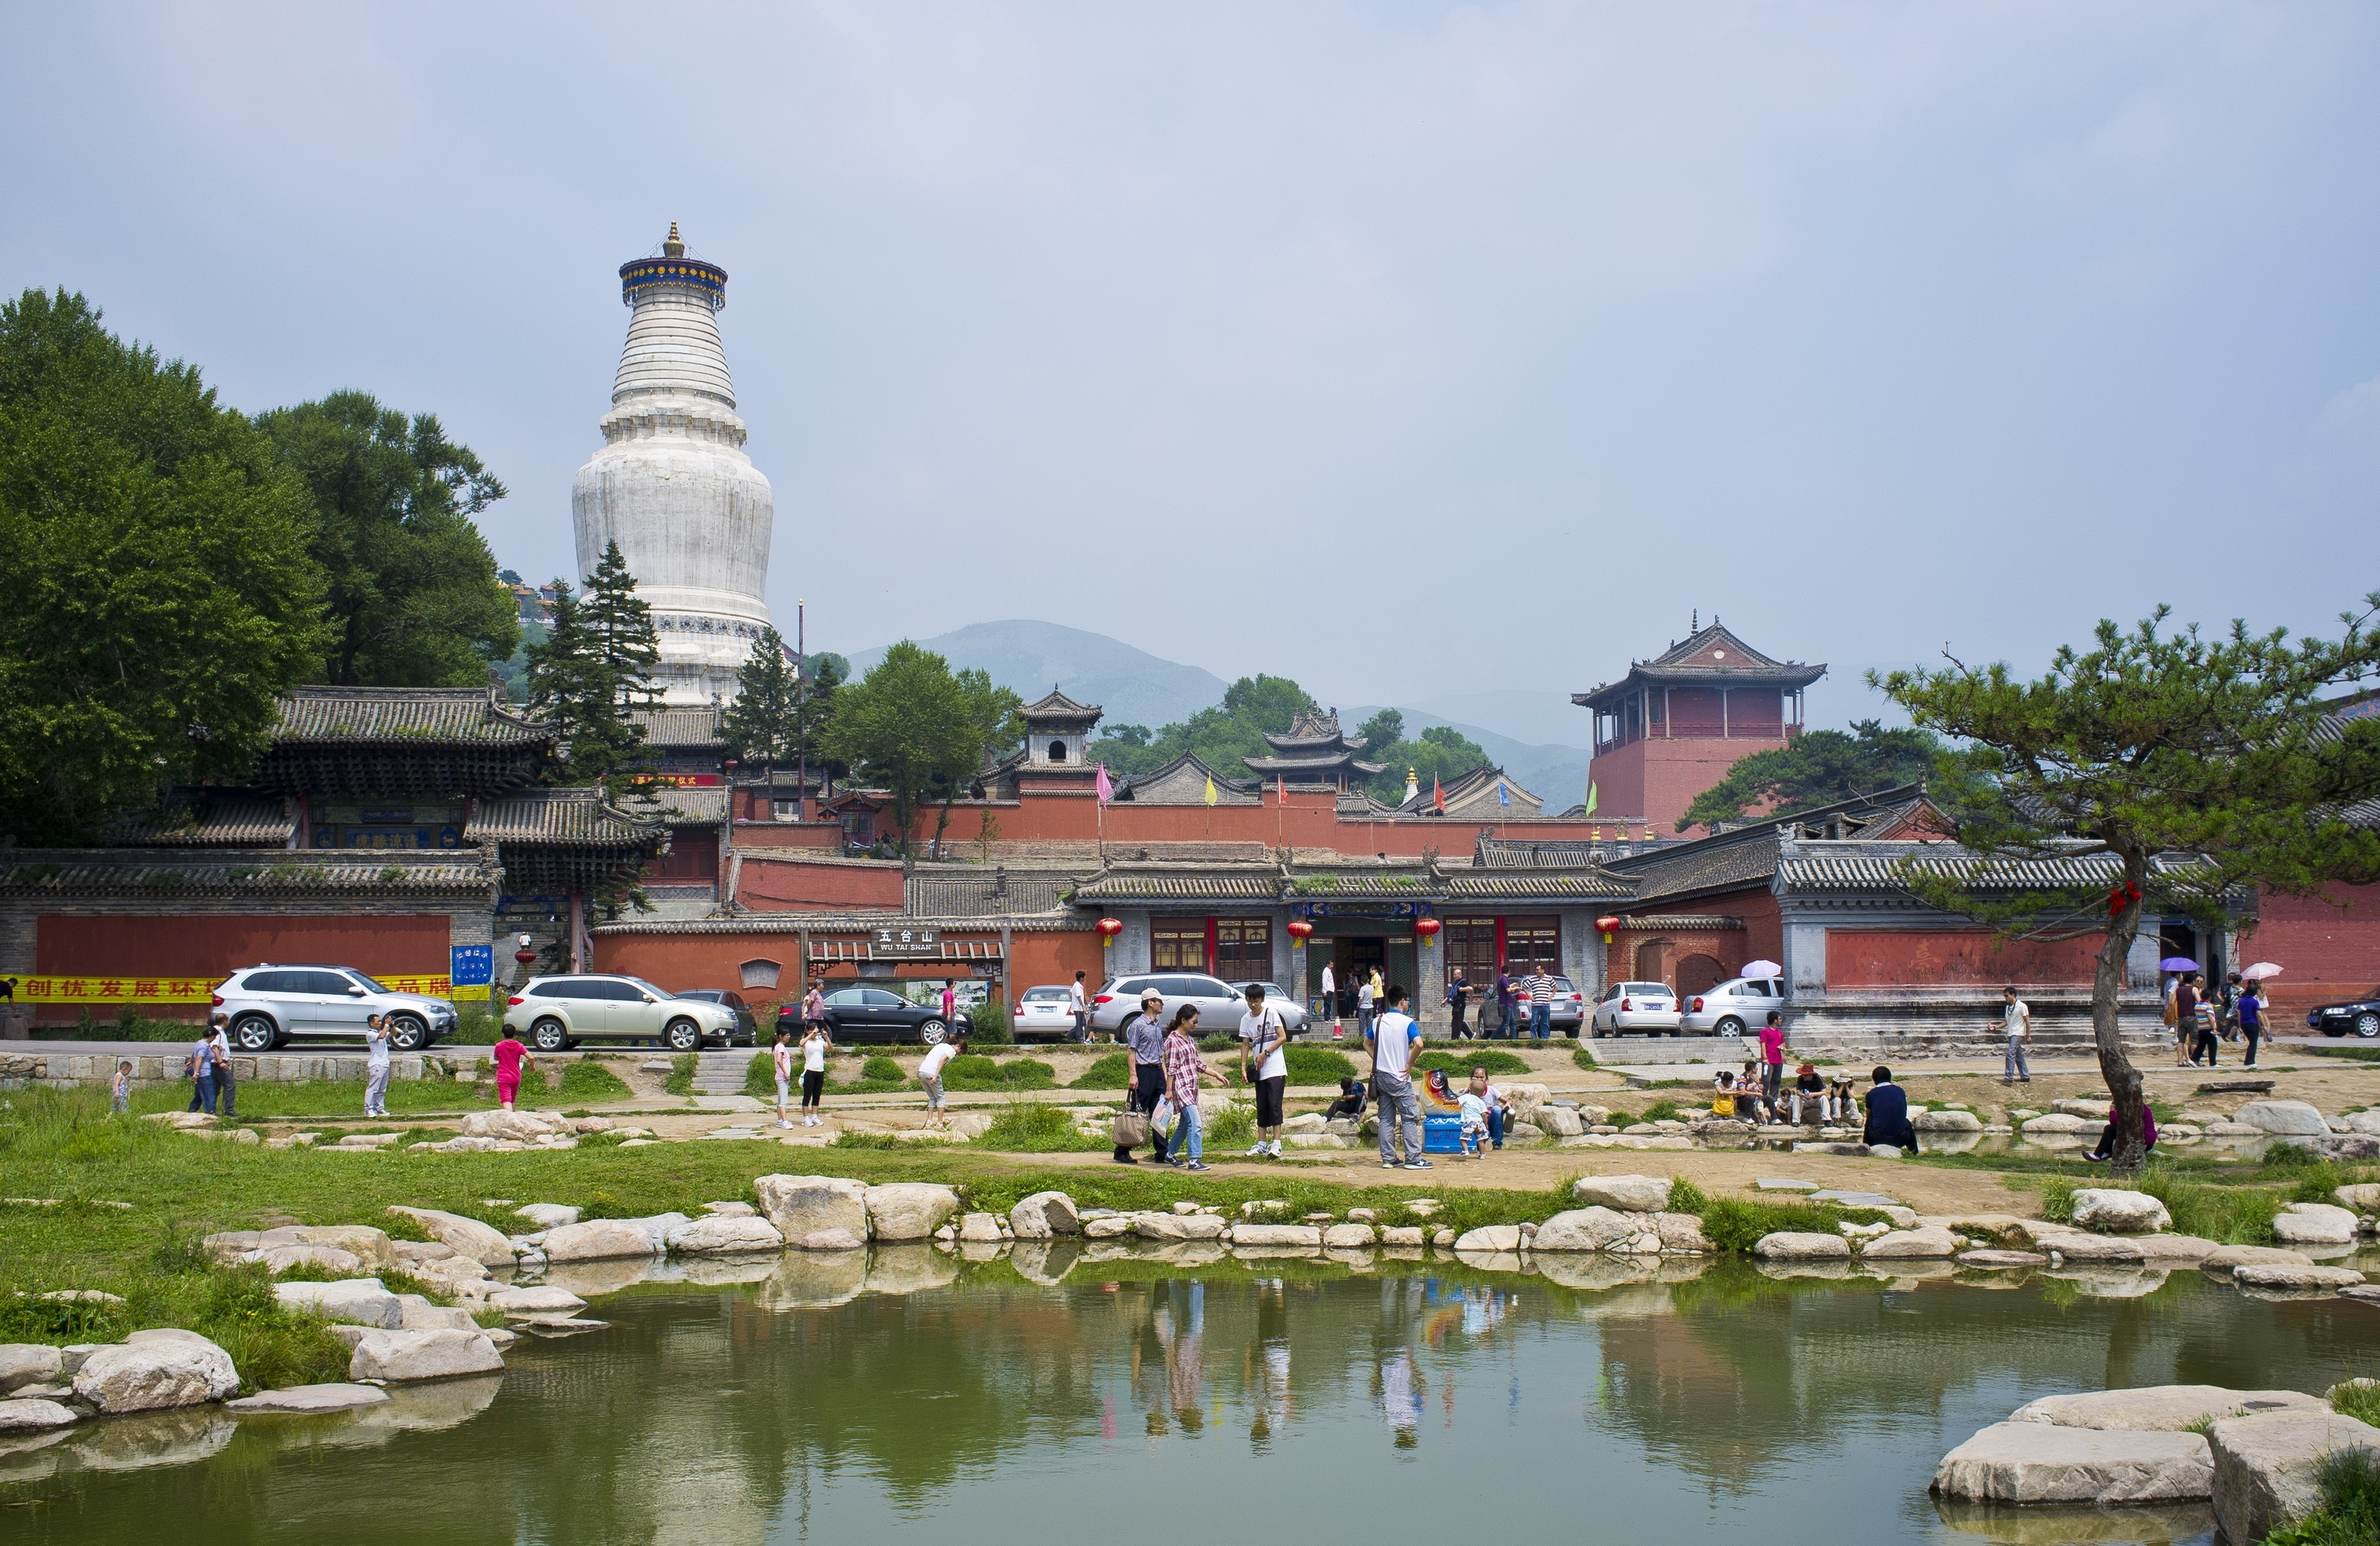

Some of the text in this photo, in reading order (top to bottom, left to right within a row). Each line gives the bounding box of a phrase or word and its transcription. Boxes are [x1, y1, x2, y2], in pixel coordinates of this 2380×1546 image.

[879, 929, 933, 943] 五台山
[377, 978, 456, 995] 品牌
